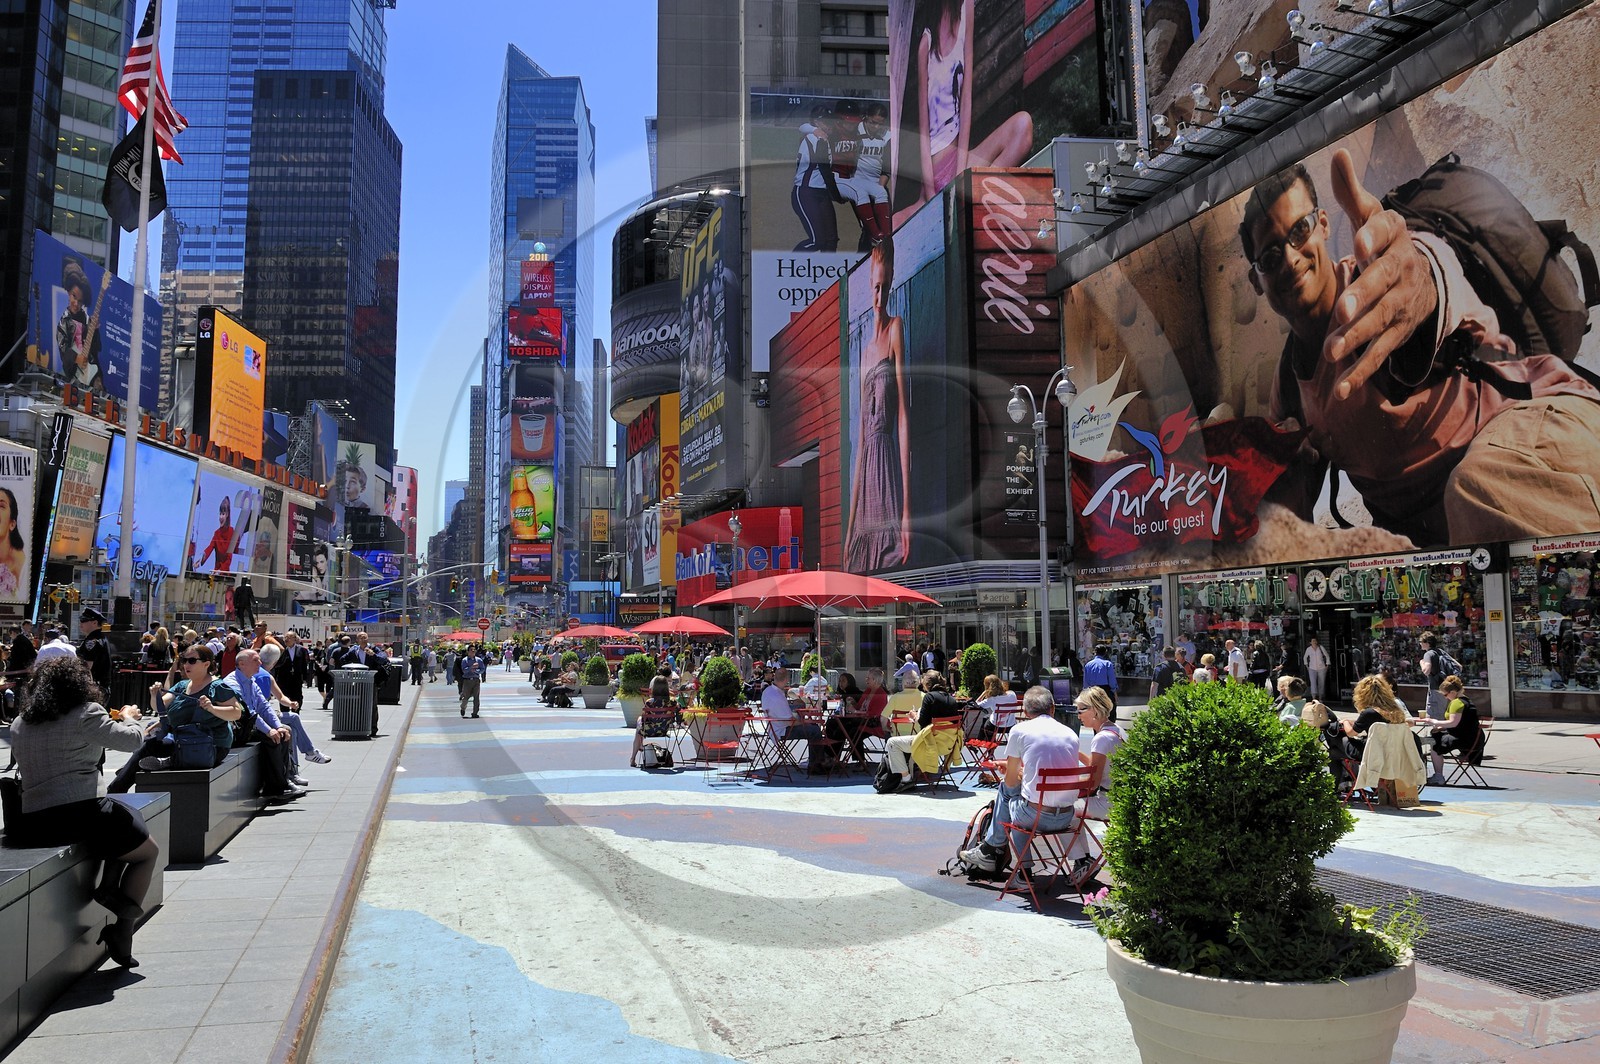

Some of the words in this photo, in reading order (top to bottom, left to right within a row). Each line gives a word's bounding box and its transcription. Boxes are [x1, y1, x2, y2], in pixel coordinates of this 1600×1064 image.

[681, 207, 722, 303] UFC
[981, 177, 1050, 334] aerie
[523, 272, 553, 283] WIRELESS
[776, 258, 848, 283] Helped
[523, 292, 552, 300] LAPTOP
[229, 341, 239, 354] LG
[509, 347, 560, 356] TOSHIBA
[628, 404, 656, 457] Kodak
[70, 446, 89, 460] YOU'VE
[683, 434, 704, 456] SATURDAY
[12, 456, 31, 477] MIA!
[1006, 465, 1035, 473] POMPEII
[1082, 463, 1227, 535] Turkey
[593, 521, 607, 529] LION
[1133, 517, 1147, 535] be
[1150, 518, 1170, 532] our
[1173, 511, 1205, 534] guest
[675, 548, 697, 581] Bank
[1096, 566, 1111, 574] TURKEY
[1541, 571, 1555, 579] NY
[1207, 578, 1285, 607] GRAND
[1343, 569, 1429, 602] SLAM
